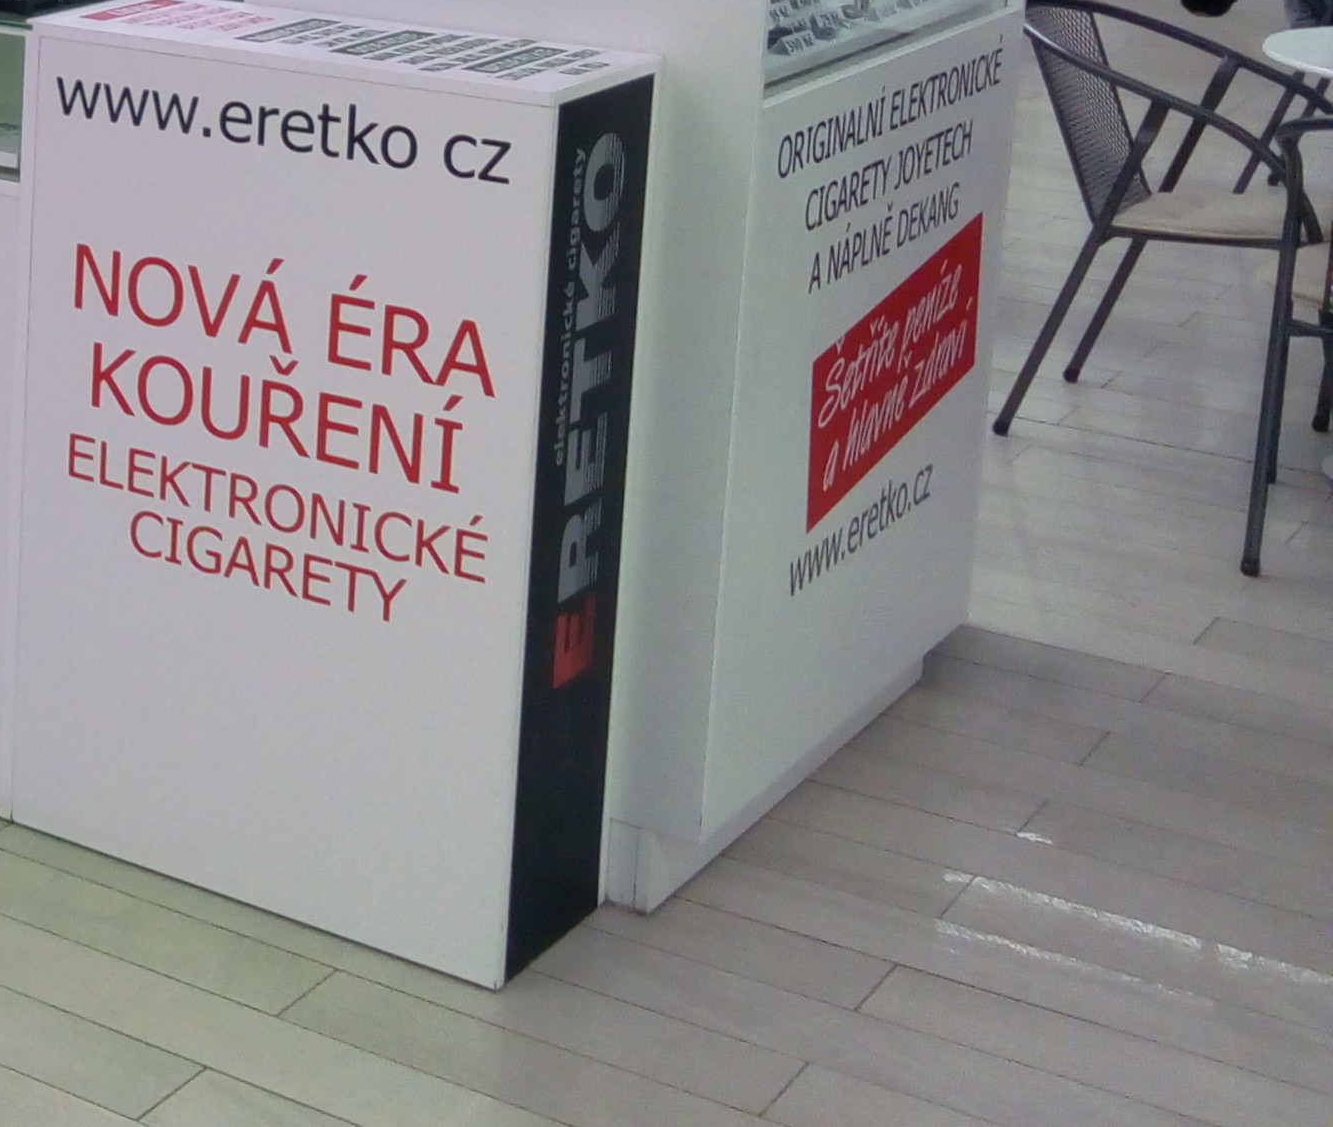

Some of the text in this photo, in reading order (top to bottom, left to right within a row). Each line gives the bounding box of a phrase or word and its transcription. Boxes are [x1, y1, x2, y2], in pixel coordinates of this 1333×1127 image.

[889, 34, 1004, 131] ELEKTRONICKÉ
[565, 146, 586, 271] cigarety
[805, 119, 974, 231] CIGARETY JOYETECH
[808, 182, 961, 295] A NÁPLNĚ DEKANG
[73, 243, 496, 400] NOVÁ ÉRA
[817, 258, 964, 429] Šetříte peníze
[90, 341, 464, 496] KOUŘENÍ
[552, 131, 625, 690] ERETKO
[821, 296, 974, 493] a hlavně zdraví
[68, 432, 489, 585] ELEKTRONICKÉ
[129, 510, 408, 623] CIGARETY
[789, 464, 934, 598] www.eretko.cz
